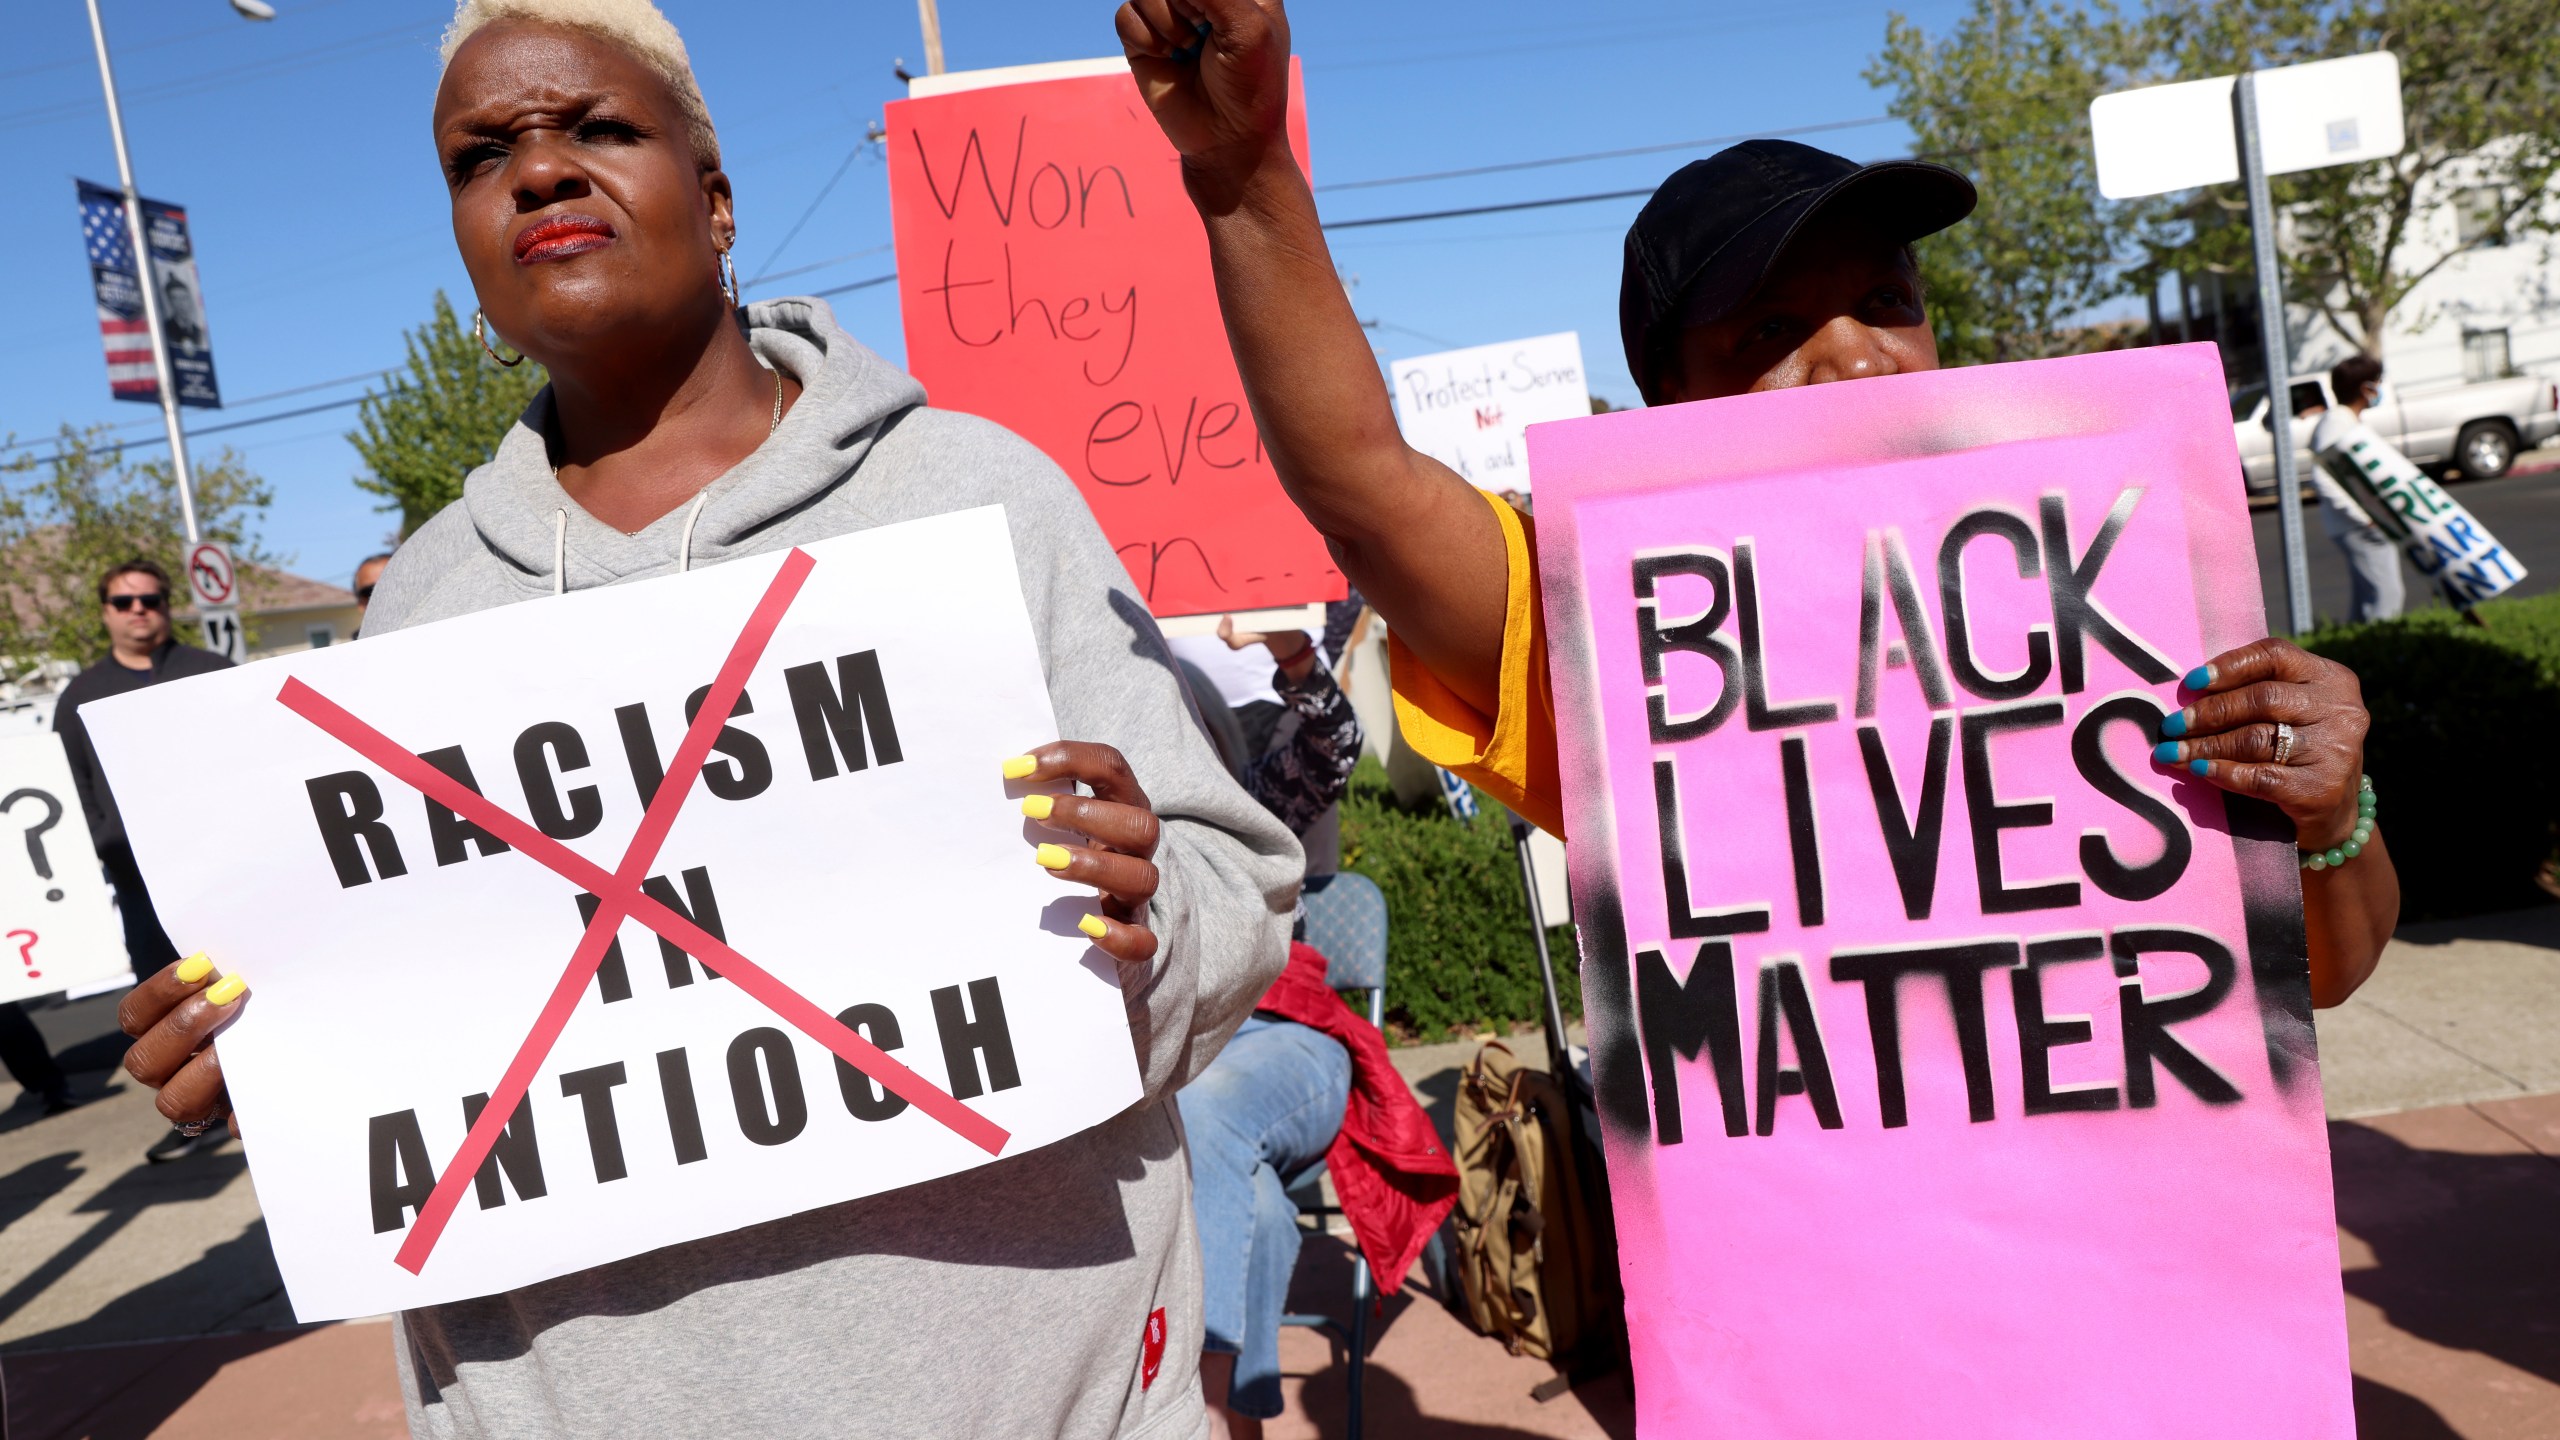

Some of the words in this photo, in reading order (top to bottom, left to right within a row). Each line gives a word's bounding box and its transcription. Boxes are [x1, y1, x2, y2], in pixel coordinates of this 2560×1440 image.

[922, 239, 1137, 386] they
[1403, 361, 1493, 413] Protect
[1508, 350, 1579, 393] Serve
[1086, 396, 1262, 486] eve
[1632, 487, 2182, 742] BLACK
[305, 648, 905, 889] RACISM
[1653, 693, 2192, 940] LIVES
[575, 866, 729, 1005] IN
[1636, 928, 2245, 1145] MATTER
[369, 976, 1022, 1235] ANTIOCH
